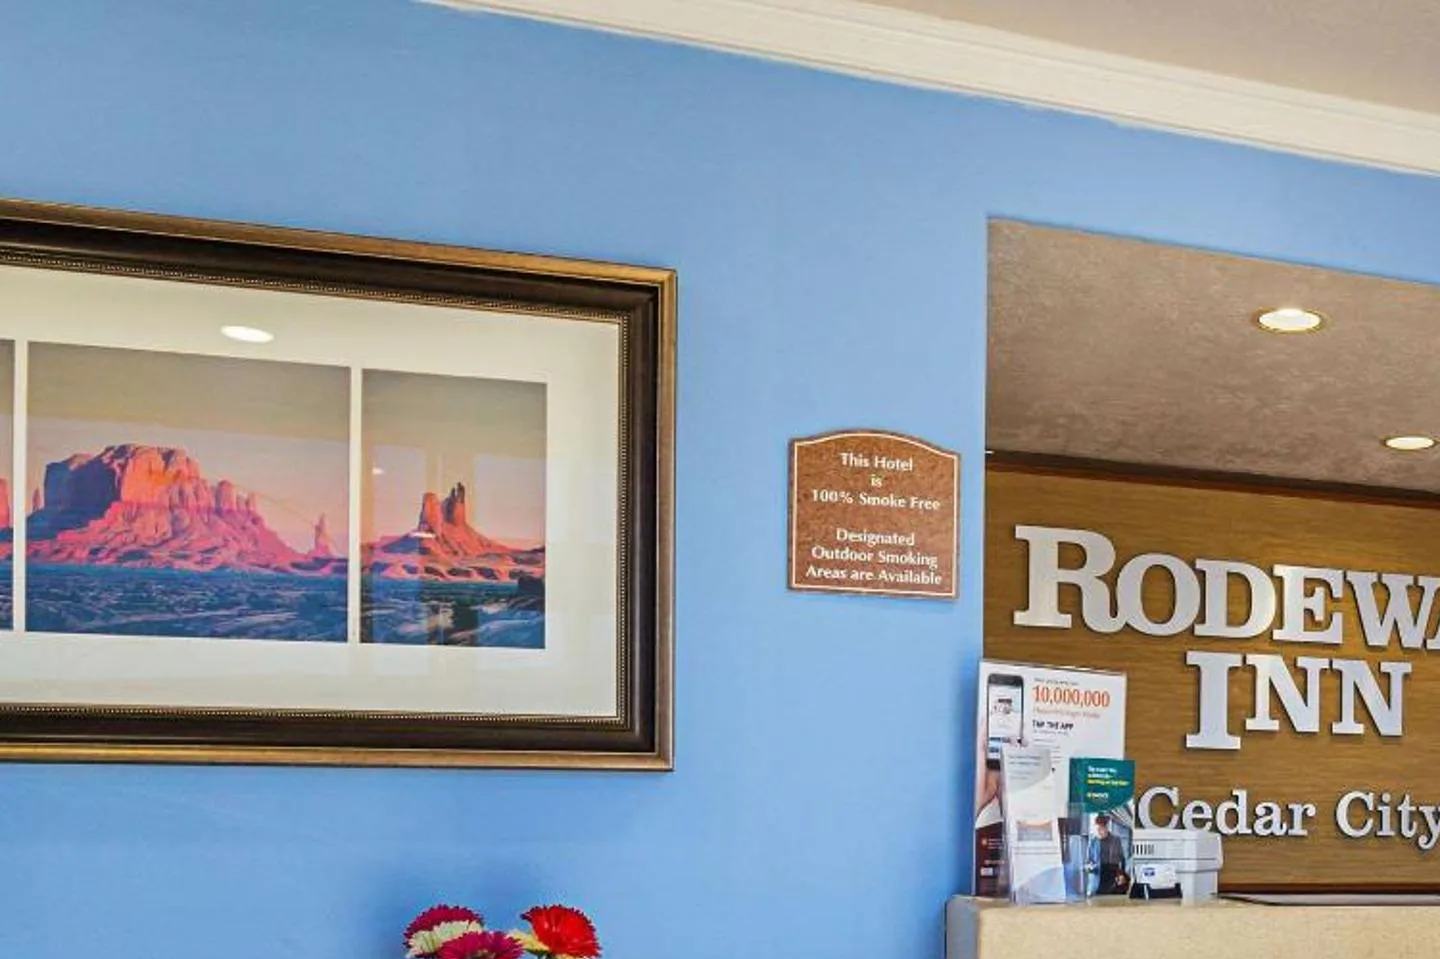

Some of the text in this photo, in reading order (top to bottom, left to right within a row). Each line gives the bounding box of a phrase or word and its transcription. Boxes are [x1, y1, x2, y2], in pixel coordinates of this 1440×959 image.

[840, 452, 914, 471] This Hotel
[870, 474, 883, 487] is
[812, 489, 941, 511] 100% Smoke Free
[836, 528, 916, 547] Designated
[811, 545, 938, 569] Outdoor Smoking
[806, 565, 943, 585] Areas are Available
[1032, 685, 1111, 708] 10,000,000
[1185, 651, 1413, 751] INN
[1138, 787, 1316, 837] Cedar
